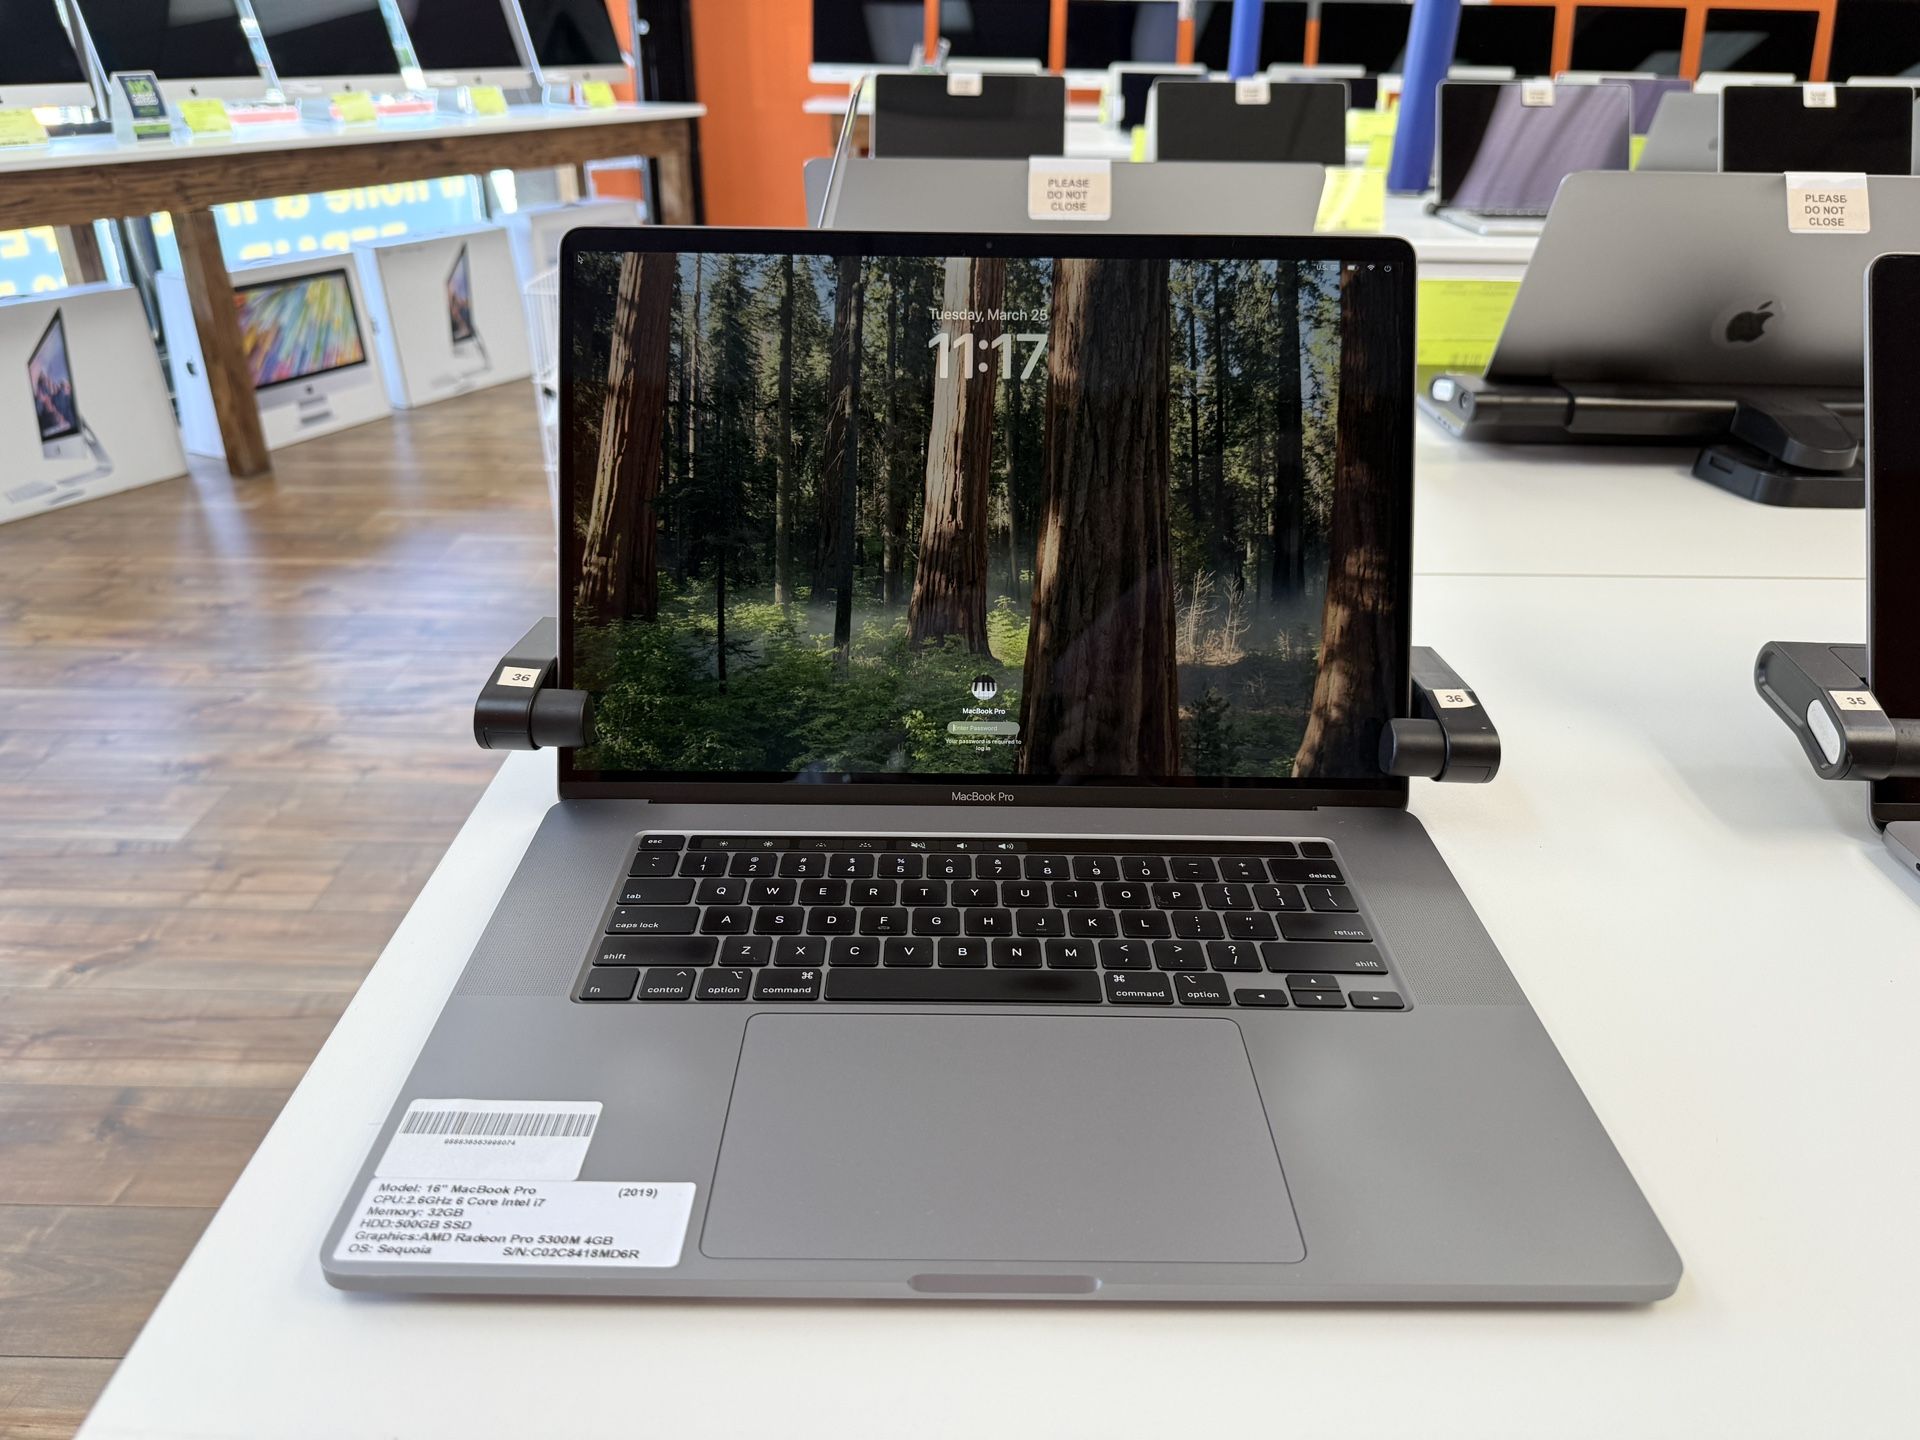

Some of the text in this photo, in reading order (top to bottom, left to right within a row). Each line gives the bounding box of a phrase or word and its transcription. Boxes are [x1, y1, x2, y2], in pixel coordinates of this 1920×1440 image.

[1048, 178, 1090, 188] PLEASE
[1046, 190, 1088, 200] DO NOT
[1805, 194, 1848, 203] PLEASE
[1050, 202, 1086, 211] CLOSE
[1804, 206, 1845, 215] DO NOT
[1808, 218, 1844, 226] CLOSE
[928, 308, 1048, 322] Tuesday, March 25
[928, 333, 1048, 380] 11:17
[512, 674, 530, 682] 36
[1446, 694, 1464, 702] 36
[952, 792, 1014, 802] MacBook Pro
[716, 887, 726, 895] Q
[1224, 887, 1230, 896] {
[1273, 887, 1280, 896] }
[1226, 897, 1232, 905] [
[1278, 897, 1285, 906] ]
[721, 915, 731, 923] A
[775, 915, 784, 924] S
[827, 916, 837, 924] D
[880, 916, 888, 924] F
[931, 917, 941, 925] G
[1037, 918, 1045, 926] J
[1088, 918, 1097, 927] K
[1141, 919, 1149, 927] L
[741, 946, 751, 955] Z
[795, 946, 806, 955] X
[850, 946, 860, 955] C
[904, 947, 914, 955] V
[958, 947, 967, 956] B
[1012, 948, 1022, 956] N
[1065, 949, 1077, 957] M
[1228, 945, 1236, 954] ?
[708, 986, 740, 994] option
[378, 1183, 658, 1199] Model: 16" MacBook Pro (2019)
[373, 1195, 546, 1207] CPU:2.6GHz 6 Core Intel i7
[367, 1207, 464, 1217] Memory: 32GB
[360, 1219, 472, 1230] HDD:500GB SSD
[355, 1231, 613, 1245] Graphics:AMD Radeon Pro 5300M 4GB
[348, 1244, 432, 1255] OS: Sequoia
